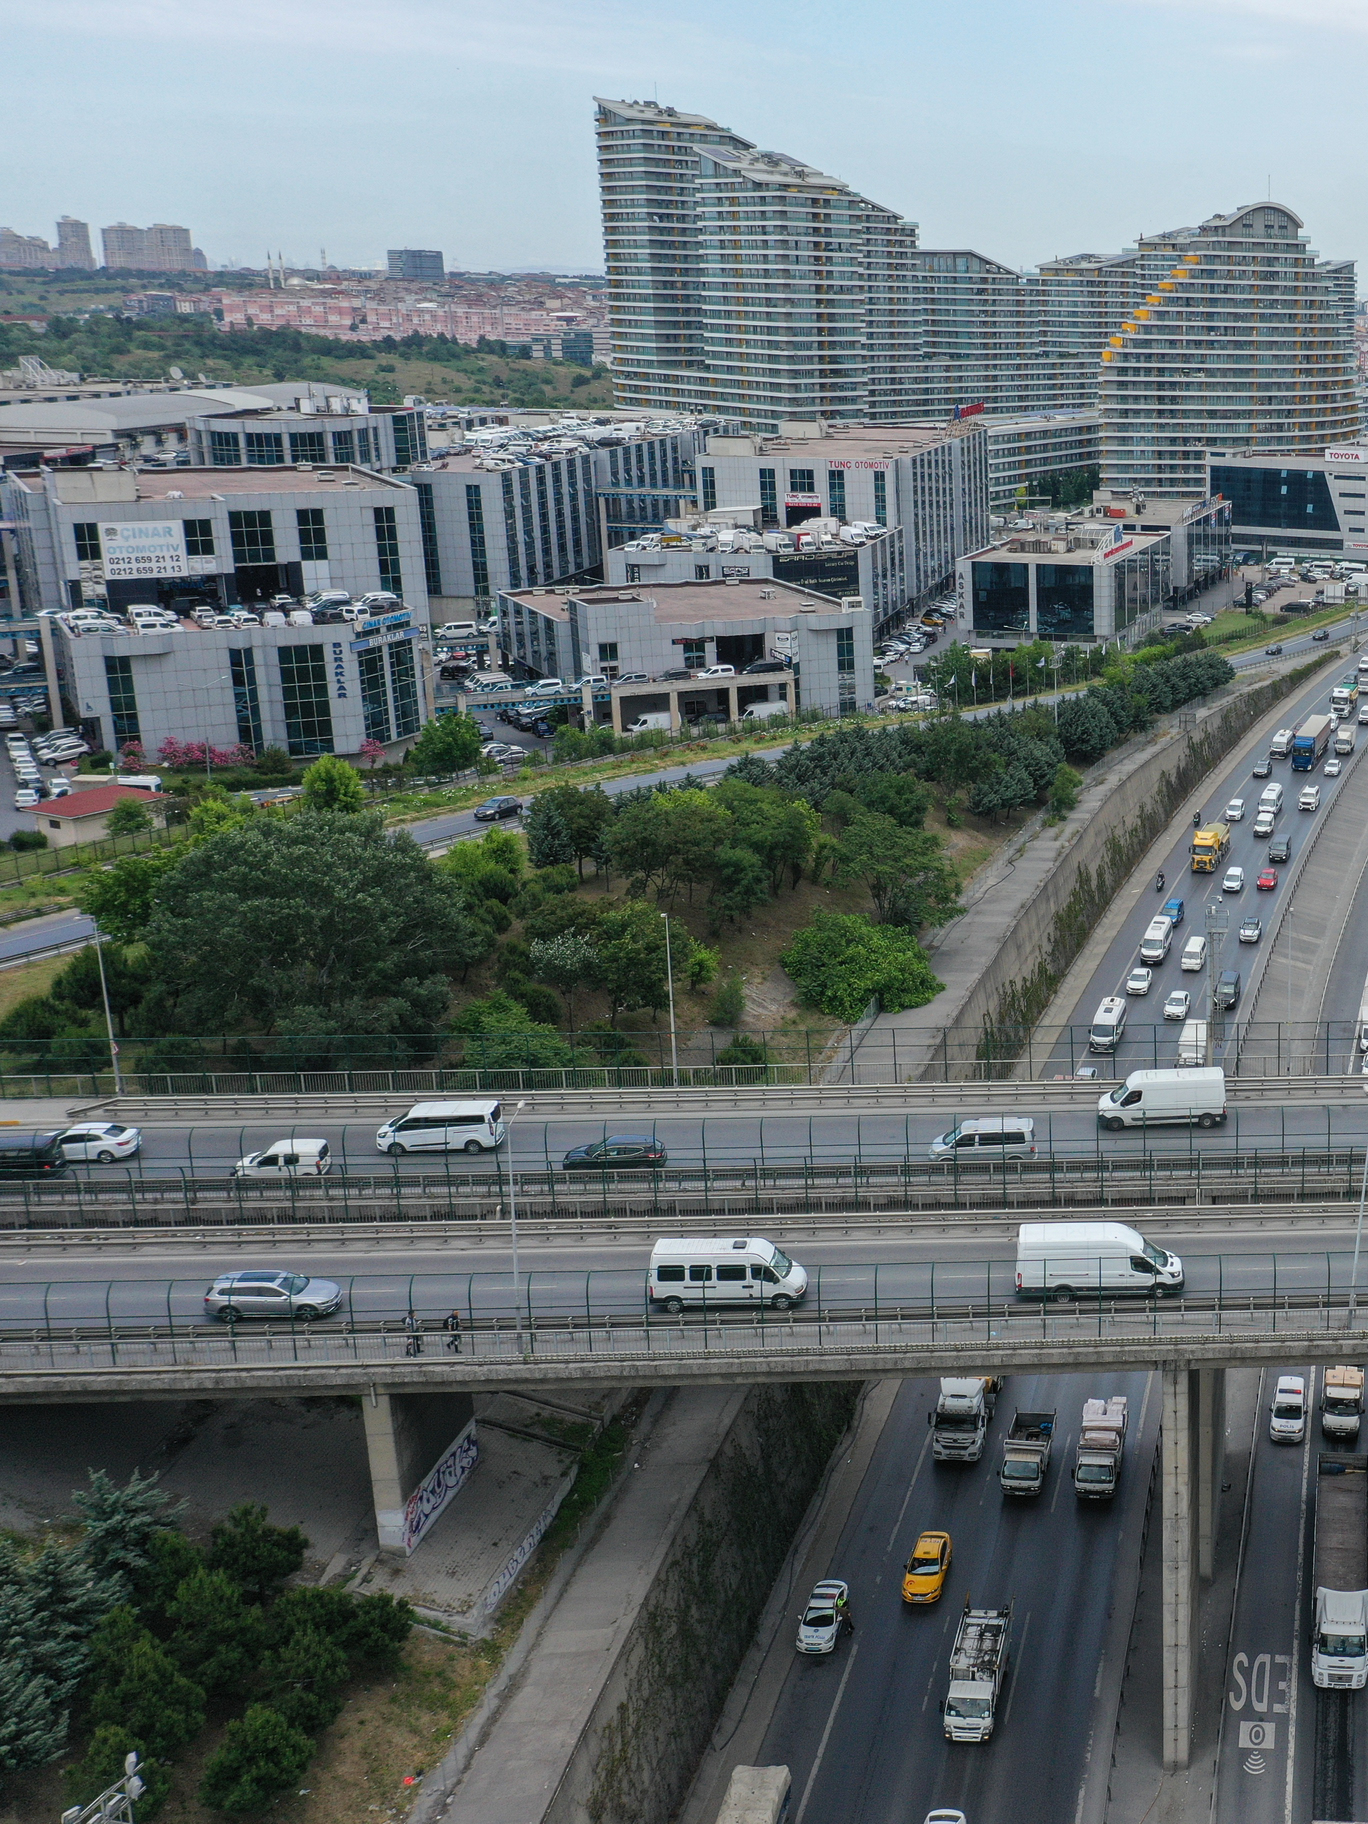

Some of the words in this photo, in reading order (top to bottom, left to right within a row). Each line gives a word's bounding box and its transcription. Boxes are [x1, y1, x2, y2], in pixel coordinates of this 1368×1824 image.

[829, 461, 851, 470] TUNÇ
[855, 461, 889, 469] OTOMOTİV
[120, 526, 174, 541] ÇINAR
[107, 542, 180, 554] OTOMOTİV
[109, 557, 132, 565] 0212
[135, 556, 152, 564] 659
[155, 556, 168, 564] 21
[170, 555, 181, 563] 12
[110, 567, 133, 576] 0212
[137, 566, 153, 574] 659
[156, 566, 168, 574] 21
[171, 565, 182, 573] 13
[957, 571, 966, 620] ASKAR
[362, 617, 382, 629] ÇINAR
[383, 612, 412, 624] OTOMOTİV
[369, 631, 405, 647] BURAKLAR
[332, 642, 347, 699] BURAKLAR
[1229, 1652, 1293, 1714] EDS
